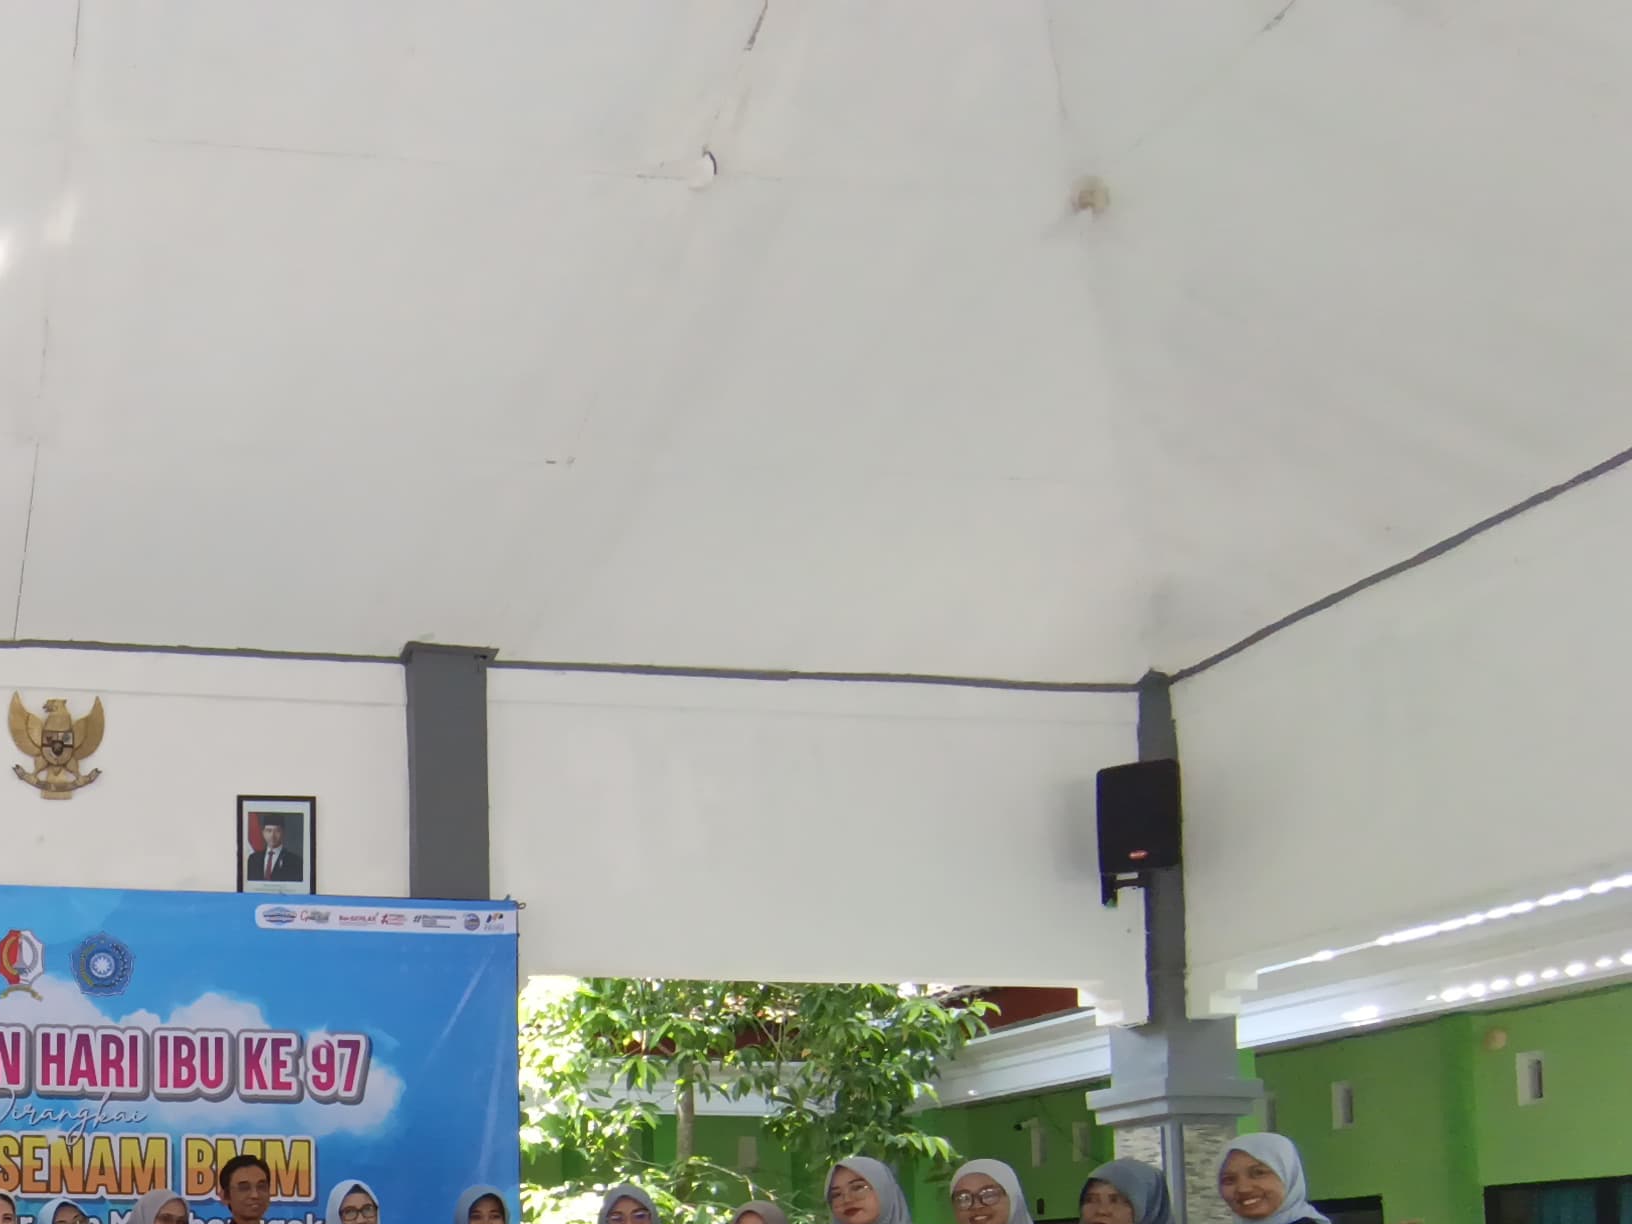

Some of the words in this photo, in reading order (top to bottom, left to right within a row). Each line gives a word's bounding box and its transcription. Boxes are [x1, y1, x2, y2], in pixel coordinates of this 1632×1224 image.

[39, 1031, 140, 1089] HARI
[157, 1034, 225, 1091] IBU
[242, 1035, 294, 1092] KE
[310, 1037, 363, 1094] 97
[183, 1135, 313, 1198] BM
